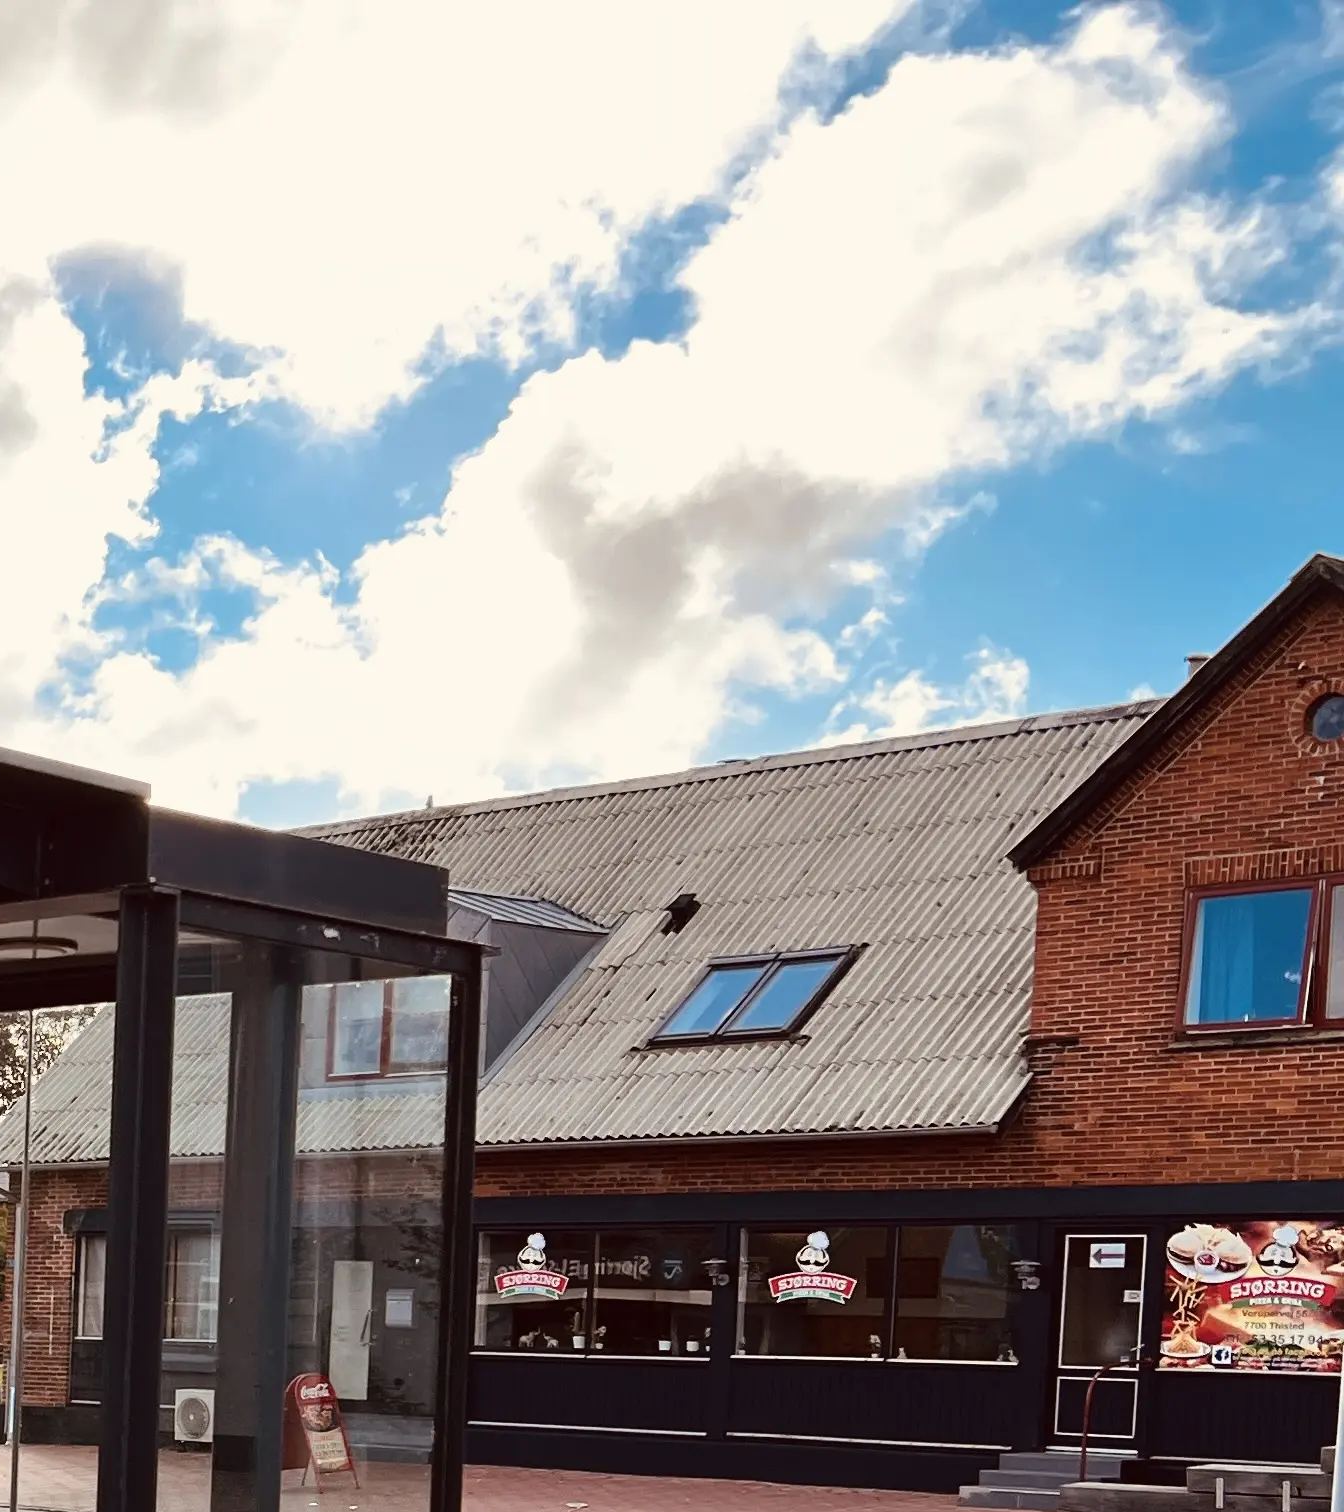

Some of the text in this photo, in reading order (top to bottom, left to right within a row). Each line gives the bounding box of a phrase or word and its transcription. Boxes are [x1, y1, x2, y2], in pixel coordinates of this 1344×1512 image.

[502, 1273, 561, 1288] SJØRRING
[778, 1276, 847, 1291] SJØRRING
[1230, 1280, 1325, 1298] SJØRRING
[1244, 1322, 1304, 1330] 7700 Thisted
[1272, 1335, 1285, 1344] 35
[1290, 1335, 1304, 1344] 17
[1308, 1335, 1323, 1345] 94
